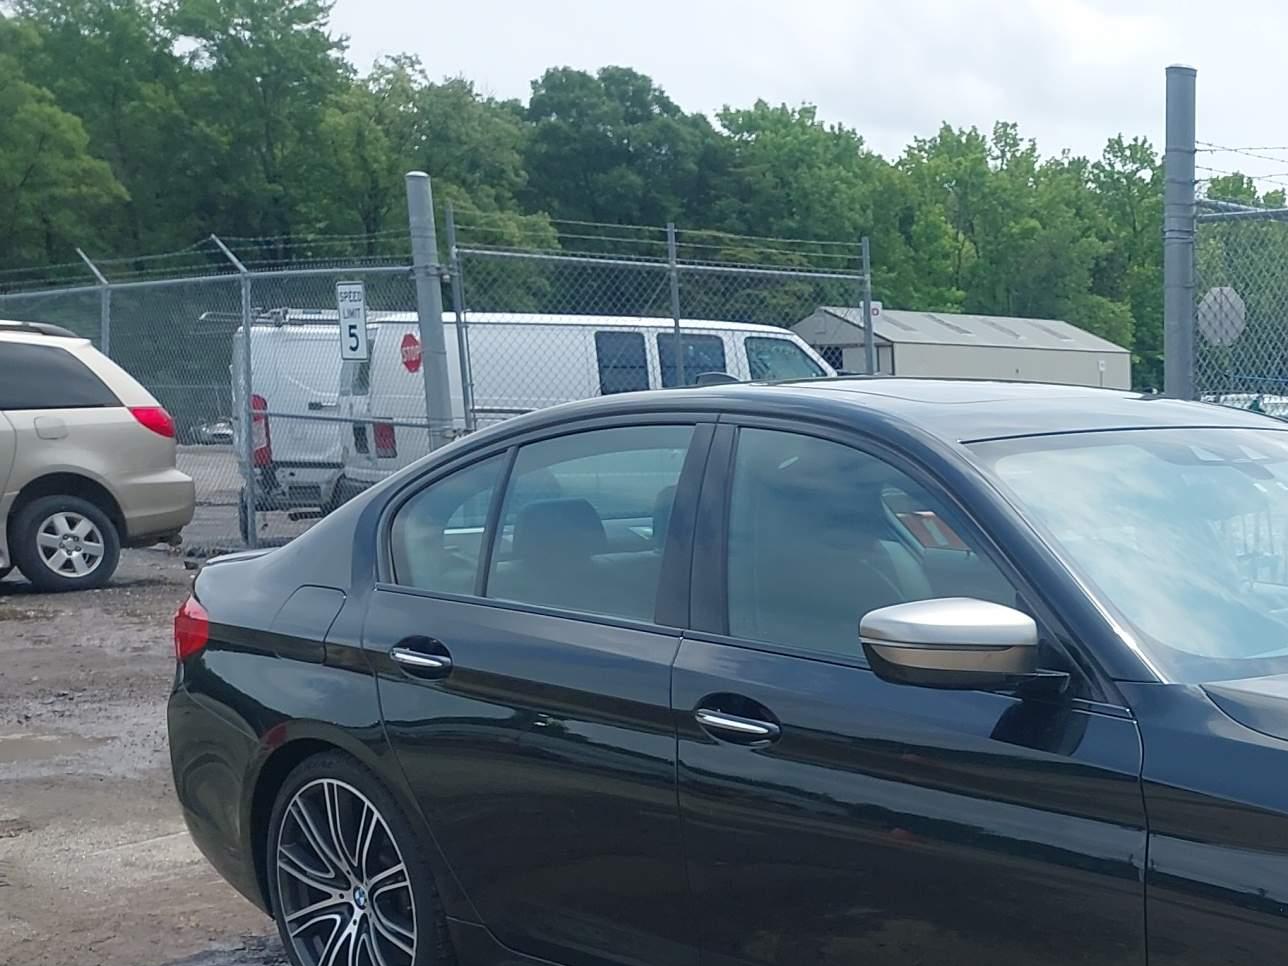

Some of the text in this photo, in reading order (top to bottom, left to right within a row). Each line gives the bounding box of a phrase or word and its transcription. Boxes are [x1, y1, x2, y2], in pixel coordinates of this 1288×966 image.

[339, 290, 362, 303] SPEED
[343, 307, 361, 320] LIMIT
[347, 324, 360, 352] 5
